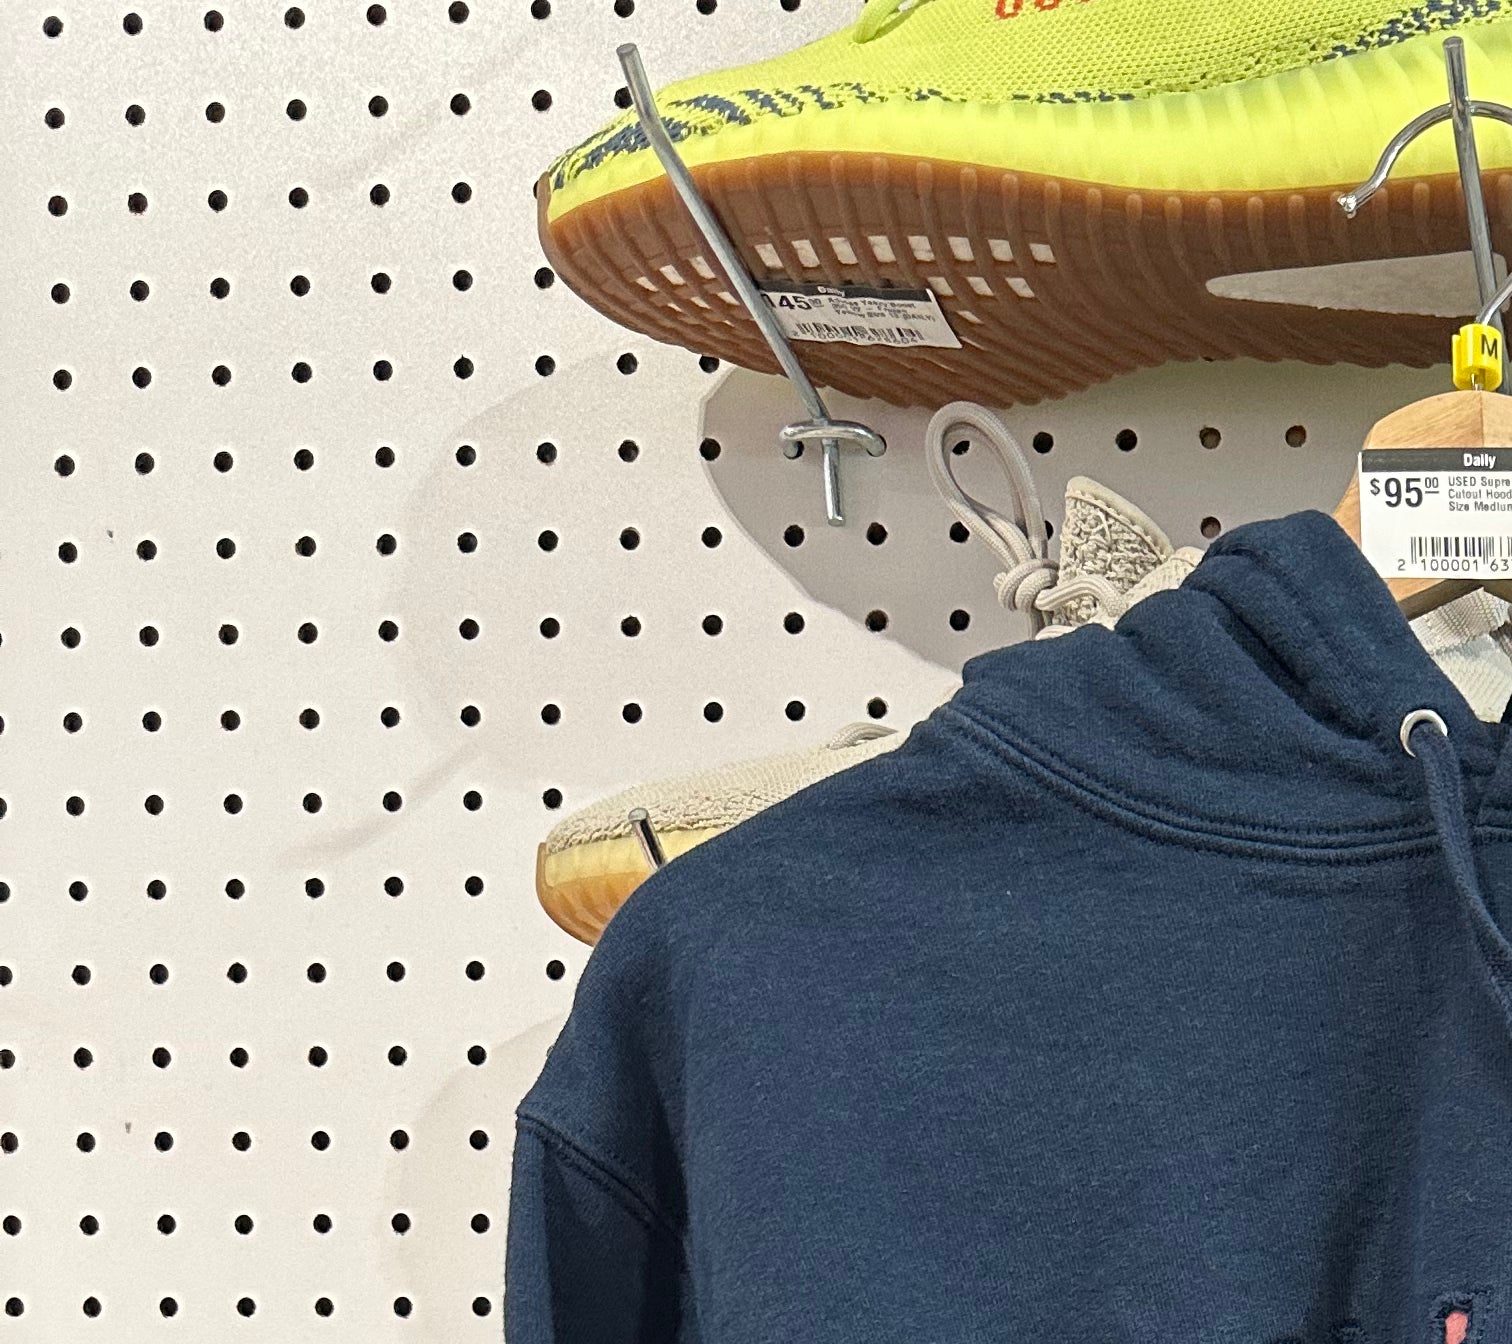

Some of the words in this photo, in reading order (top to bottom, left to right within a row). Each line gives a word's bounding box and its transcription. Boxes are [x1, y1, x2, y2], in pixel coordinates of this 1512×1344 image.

[1481, 334, 1498, 359] M
[1463, 453, 1496, 469] Daily
[1448, 476, 1476, 487] USED
[1448, 489, 1481, 499] Cutout
[1448, 501, 1470, 512] Size
[1398, 559, 1406, 571] 2
[1421, 559, 1479, 571] 100001
